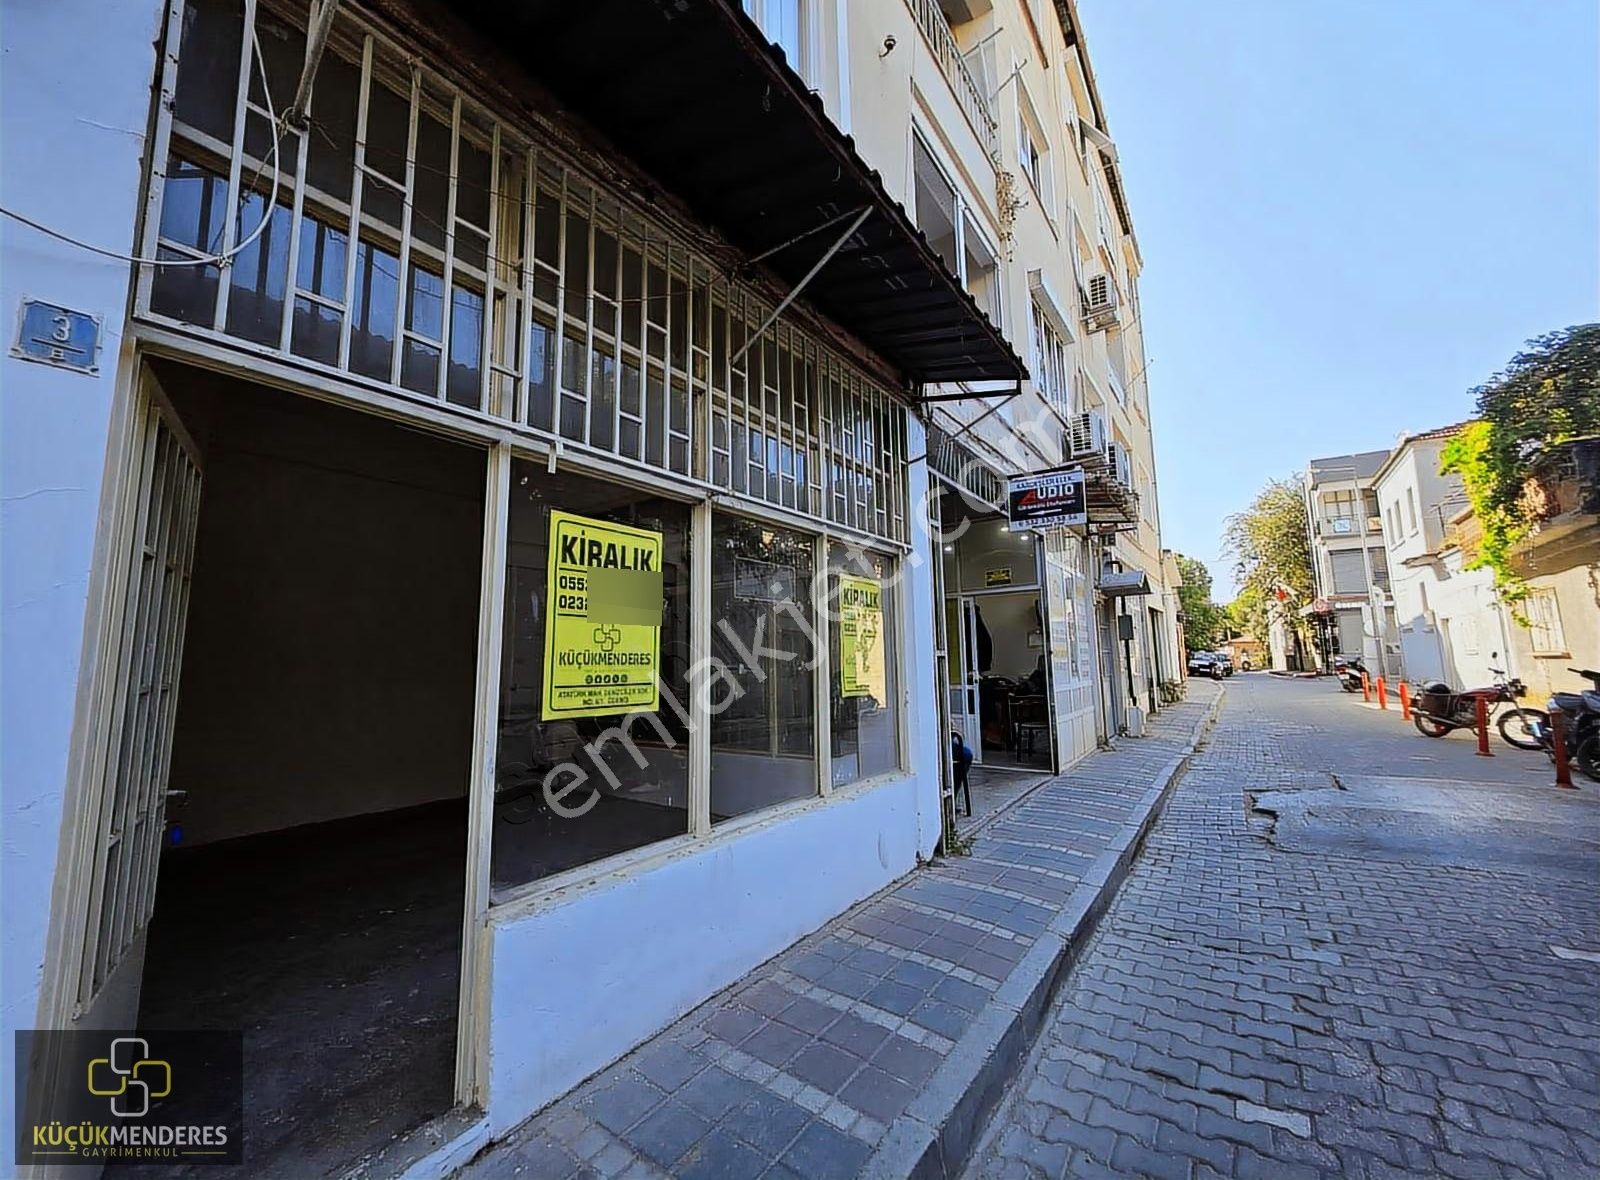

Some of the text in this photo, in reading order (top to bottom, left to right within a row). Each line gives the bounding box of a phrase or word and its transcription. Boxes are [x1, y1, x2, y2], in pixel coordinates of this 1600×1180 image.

[52, 315, 71, 341] 3
[561, 529, 654, 572] KİRALIK
[559, 575, 588, 592] 055
[559, 594, 588, 611] 023
[843, 584, 879, 609] KİRALIK
[559, 649, 651, 670] KÜÇÜKMENDERES
